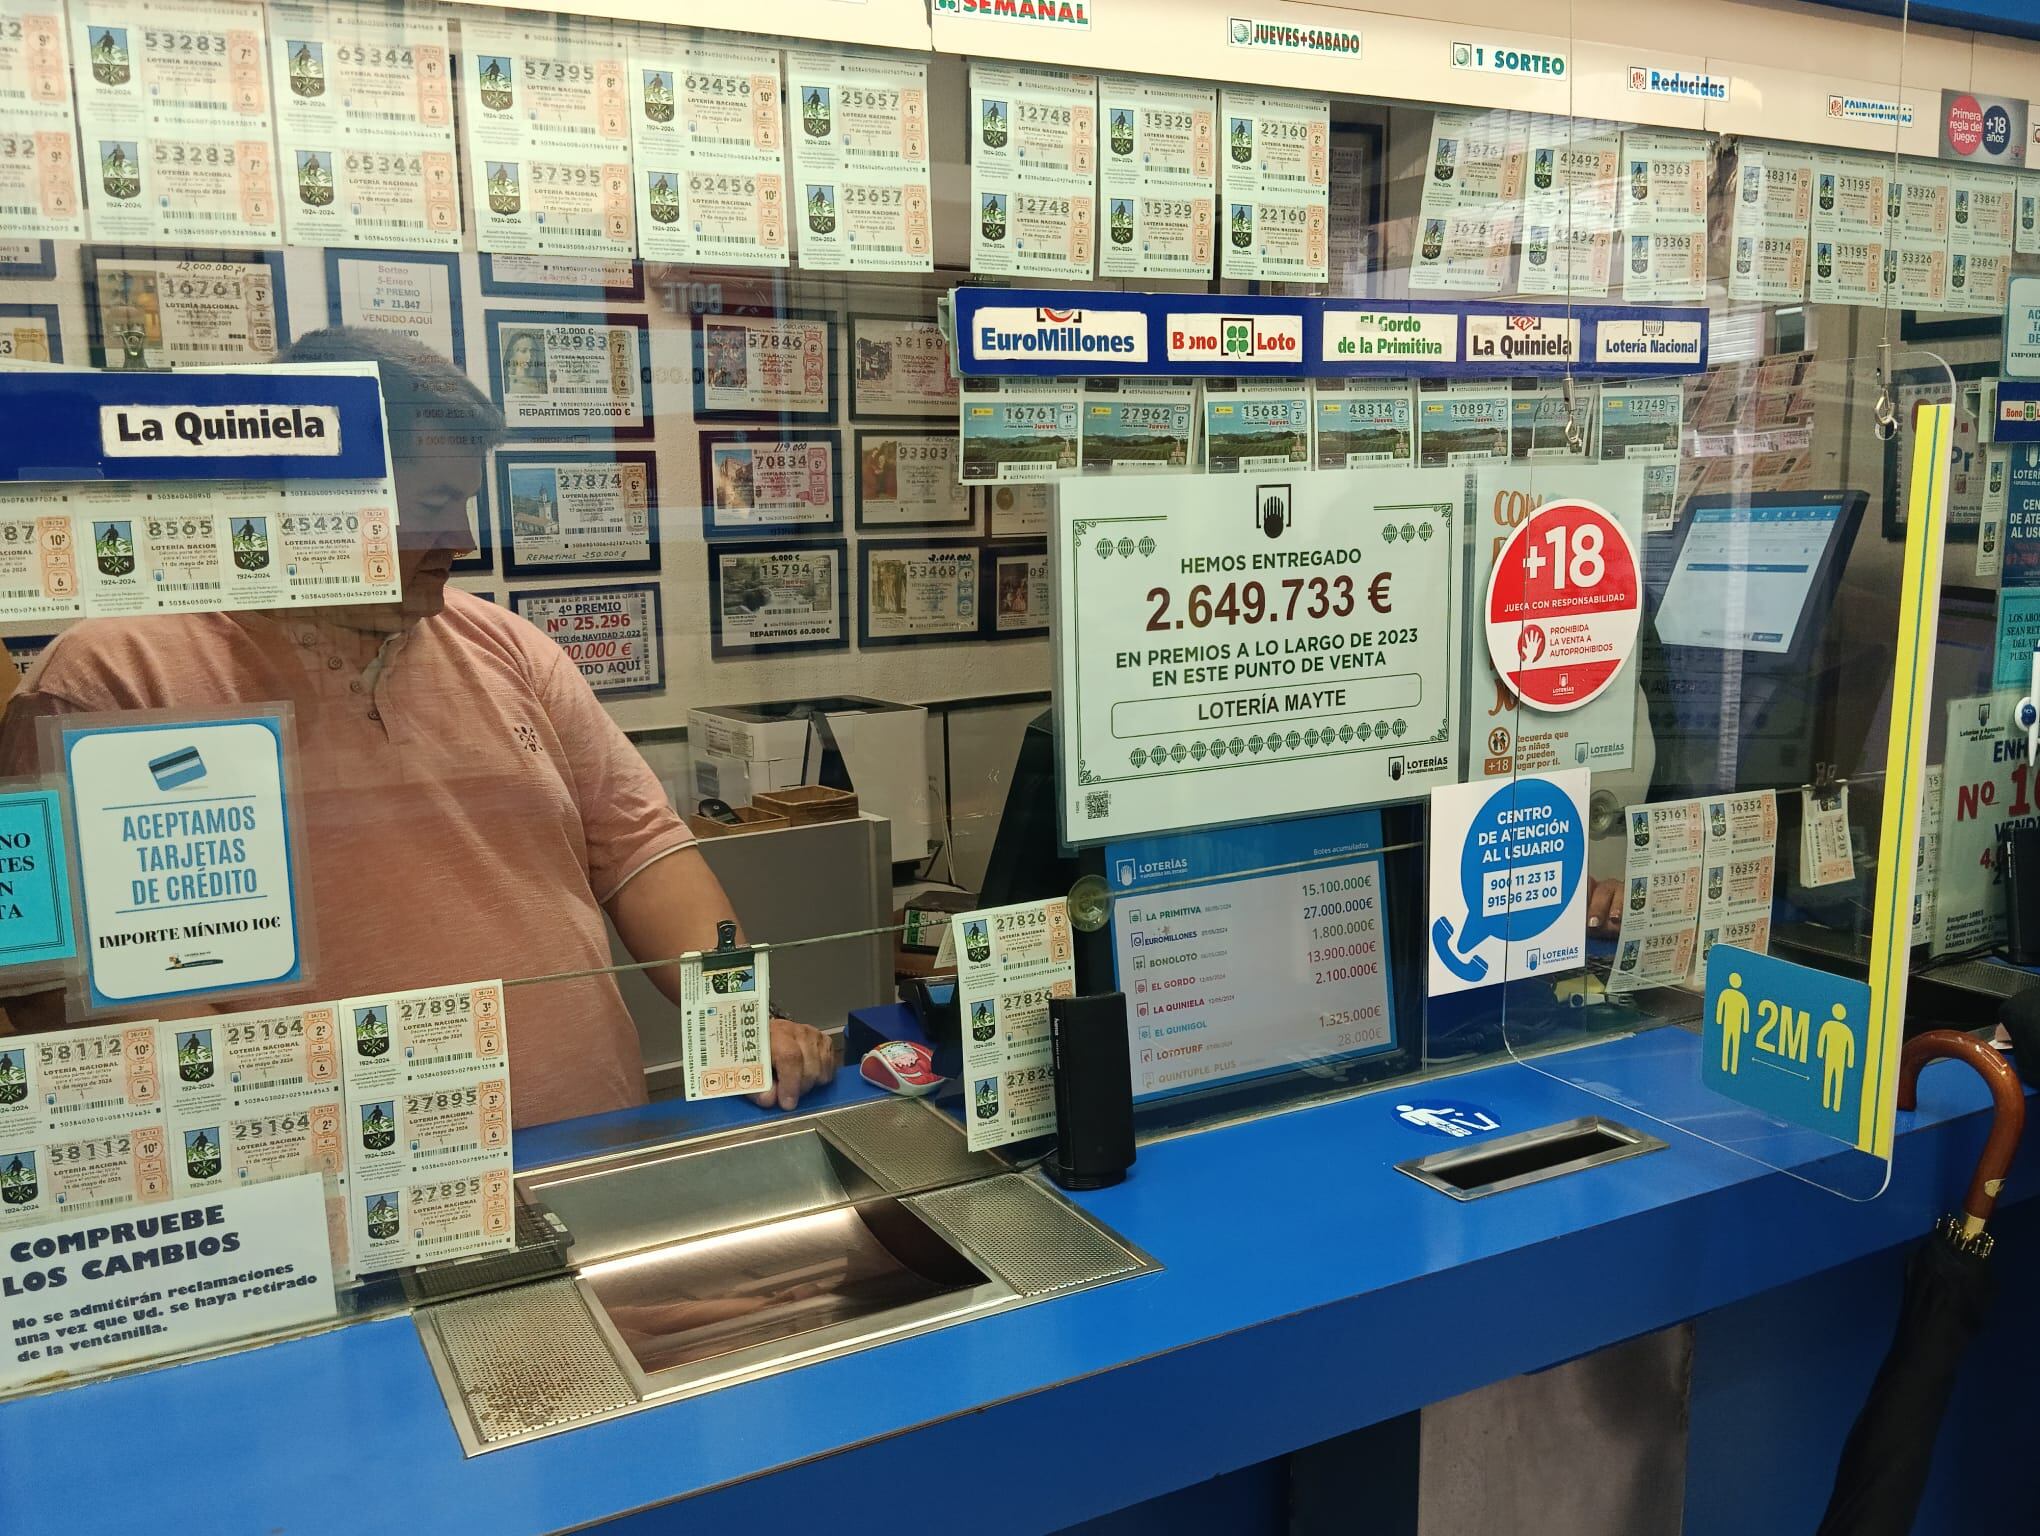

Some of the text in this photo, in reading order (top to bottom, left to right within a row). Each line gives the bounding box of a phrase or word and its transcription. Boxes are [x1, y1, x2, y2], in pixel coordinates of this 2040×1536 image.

[964, 0, 1088, 25] SEMANAL
[144, 32, 227, 52] 53283
[1253, 23, 1360, 54] JUEVES+SABADO
[337, 46, 413, 66] 65344
[1476, 48, 1565, 75] 1 SORTEO
[524, 62, 594, 81] 57395
[685, 75, 751, 95] 62456
[1651, 71, 1725, 97] Reducidas
[841, 91, 899, 107] 25657
[1144, 113, 1192, 129] 15329
[1952, 108, 1980, 121] Primera
[1950, 120, 1982, 132] regla del
[1986, 117, 2006, 134] +18
[1986, 132, 2004, 143] años
[1840, 177, 1870, 190] 31195
[548, 337, 607, 350] 44983
[982, 327, 1135, 353] EuroMillones
[1257, 331, 1296, 351] Loto
[1338, 336, 1442, 354] de la Primitiva
[1473, 334, 1572, 359] La Quiniela
[1606, 338, 1698, 353] Lotería Nacional
[519, 408, 580, 417] REPARTIMOS
[624, 408, 631, 416] €
[1006, 406, 1057, 422] 16761
[1121, 407, 1171, 422] 27962
[116, 407, 325, 446] La Quiniela
[281, 516, 358, 533] 45420
[1181, 548, 1362, 574] HEMOS ENTREGADO
[1523, 523, 1605, 590] +18
[761, 564, 810, 578] 15794
[576, 602, 621, 614] PREMIO
[1146, 571, 1392, 632] 2.649.733 €
[1532, 600, 1550, 610] CON
[1552, 594, 1625, 608] RESPONSABILIDAD
[574, 614, 630, 630] 25.296
[1550, 624, 1590, 635] PROHIBIDA
[582, 632, 618, 640] NAVIDAD
[620, 630, 641, 638] 2.022
[1550, 634, 1592, 646] LA VENTA A
[1116, 628, 1419, 669] EN PREMIOS A LO LARGO DE 2023
[1550, 643, 1613, 658] AUTOPROHIBIDOS
[1152, 651, 1387, 688] EN ESTE PUNTO DE VENTA
[1198, 689, 1346, 722] LOTERÍA MAYTE
[1528, 743, 1550, 751] niños
[1554, 731, 1568, 743] que
[1526, 751, 1556, 762] pueden
[1590, 743, 1624, 754] LOTERÍAS
[1406, 755, 1448, 769] LOTERÍAS
[1488, 760, 1508, 772] +18
[1536, 761, 1551, 769] por
[1497, 806, 1552, 825] CENTRO
[1654, 807, 1688, 822] 53161
[1730, 800, 1762, 813] 16352
[122, 806, 256, 842] ACEPTAMOS
[1478, 819, 1570, 846] DE ATENCIÓN
[137, 838, 246, 872] TARJETAS
[1482, 849, 1501, 863] AL
[1138, 858, 1188, 874] LOTERÍAS
[132, 867, 258, 905] DE CRÉDITO
[1515, 876, 1524, 887] 11
[1526, 873, 1542, 886] 23
[1544, 870, 1556, 883] 13
[1146, 911, 1157, 921] LA
[1160, 906, 1202, 918] PRIMITIVA
[1302, 876, 1372, 897] 15.100.000€
[1488, 892, 1506, 907] 915
[1526, 888, 1540, 902] 23
[1542, 886, 1558, 900] 00
[996, 912, 1048, 931] 27826
[1144, 930, 1198, 946] EUROMILLONES
[1304, 897, 1374, 920] 27.000.000€
[99, 928, 180, 948] IMPORTE
[183, 920, 249, 939] MÍNIMO
[1150, 952, 1198, 968] BONOLOTO
[1312, 918, 1375, 940] 1.800.000€
[1542, 946, 1579, 960] LOTERÍAS
[1152, 940, 1376, 991] EL GORDO 13.900.000€
[1154, 962, 1378, 1014] LA QUINIELA 2.100.000€
[400, 996, 470, 1018] 27895
[228, 1019, 304, 1043] 25164
[742, 1003, 758, 1064] 38841
[1154, 1020, 1208, 1037] EL QUINIGOL
[1156, 1044, 1204, 1060] LOTOTURF
[1319, 1005, 1381, 1028] 1.325.000€
[1754, 999, 1810, 1064] 2M
[40, 1040, 122, 1065] 58112
[1214, 1060, 1237, 1072] PLUS
[1338, 1027, 1383, 1048] 28.000€
[10, 1204, 225, 1262] COMPRUEBE
[2, 1232, 241, 1298] LOS CAMBIOS
[12, 1264, 294, 1331] No se admitirán reclamaciones
[15, 1274, 318, 1347] una vez que Ud. se haya retirado
[18, 1324, 168, 1361] de la ventanilla.
